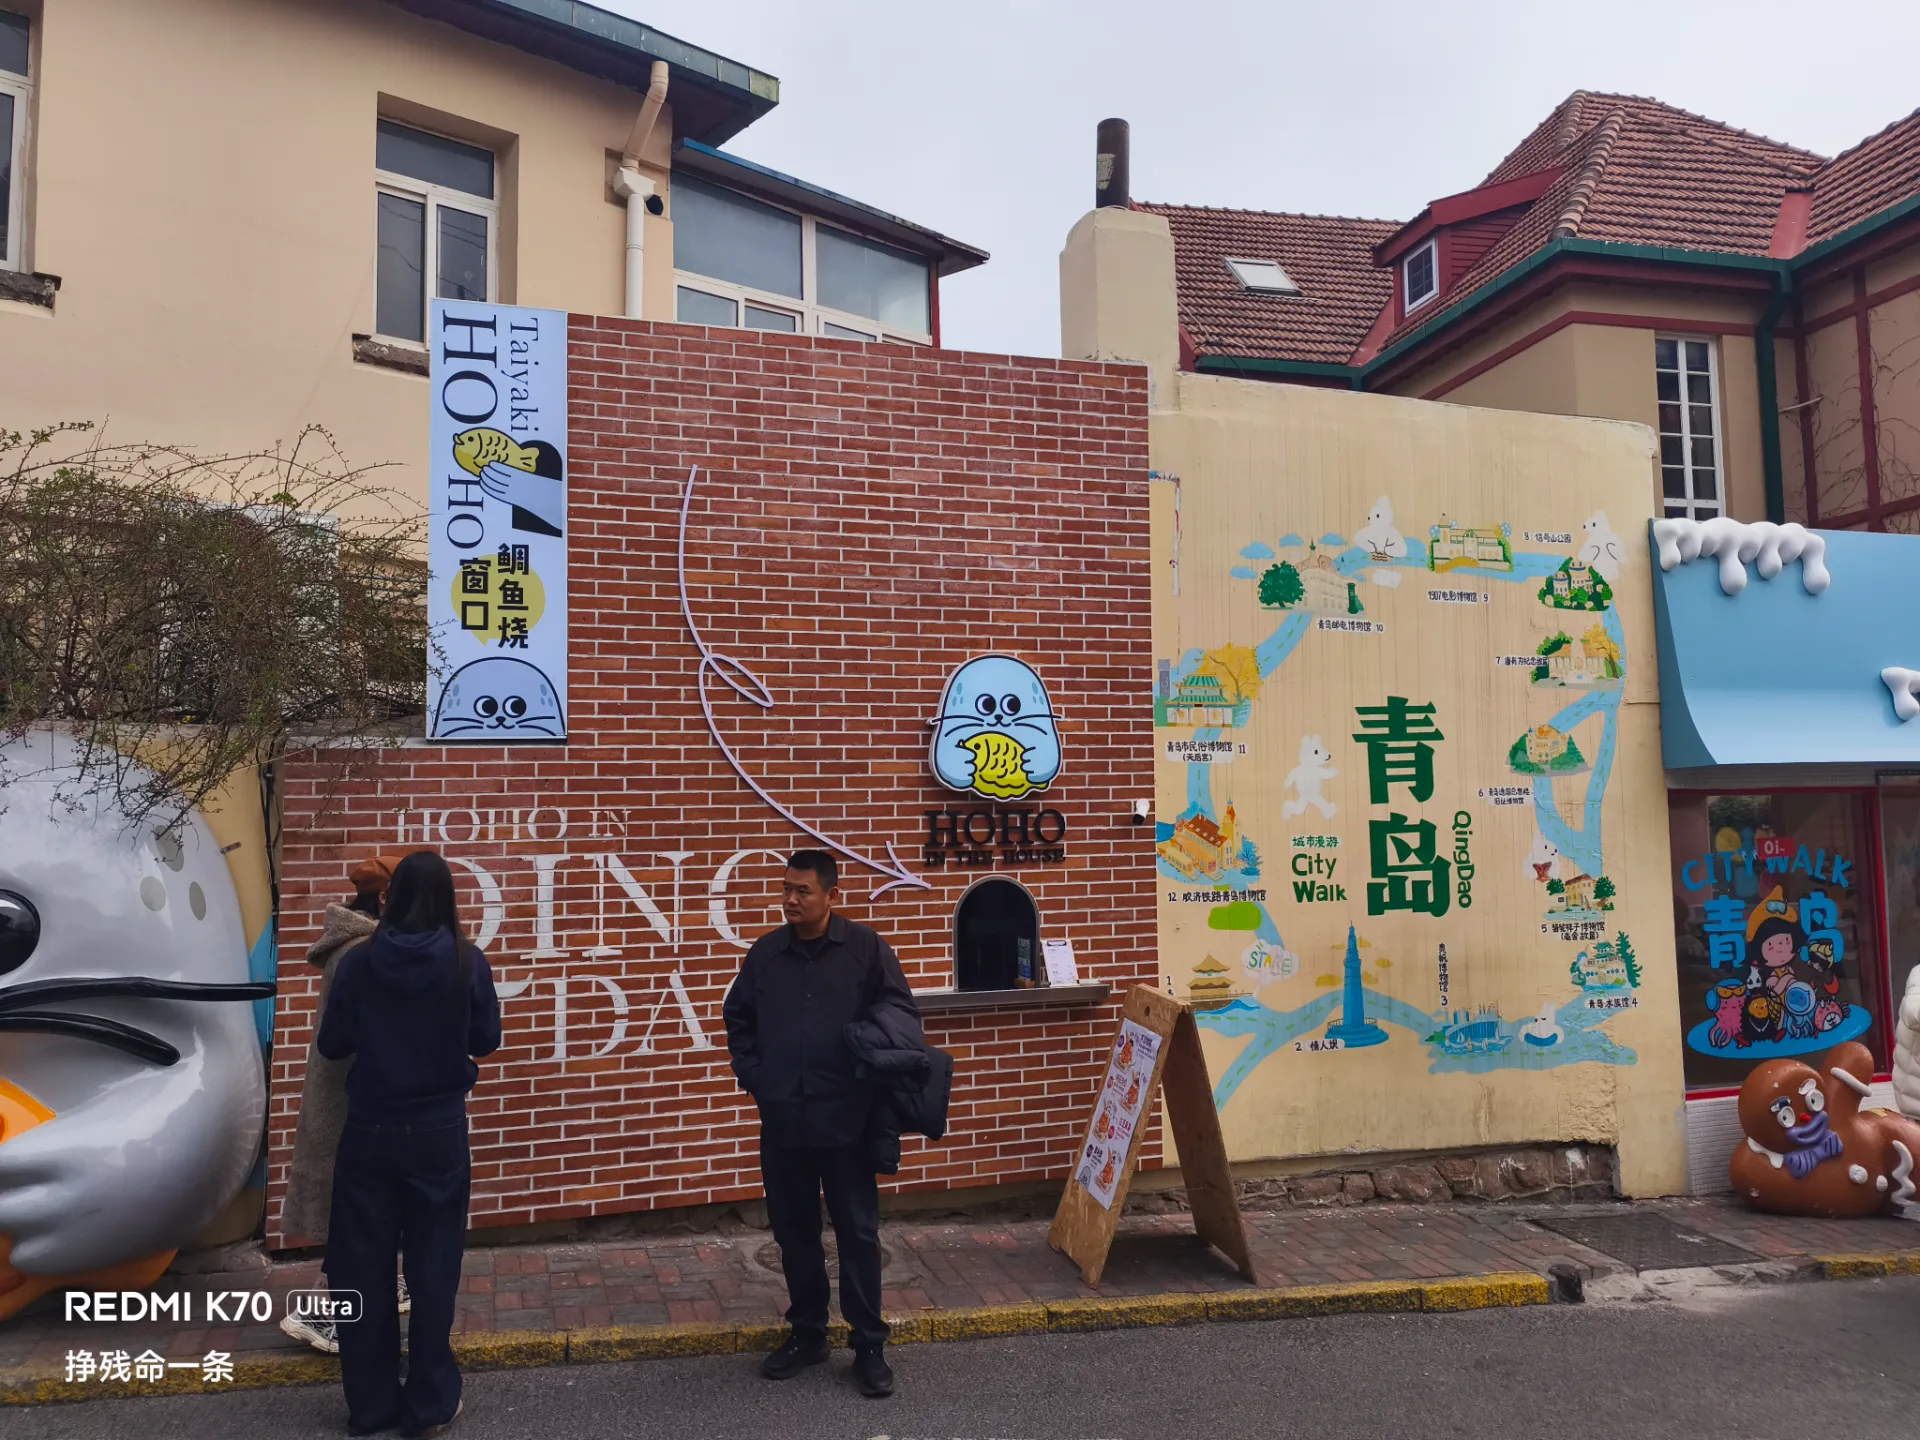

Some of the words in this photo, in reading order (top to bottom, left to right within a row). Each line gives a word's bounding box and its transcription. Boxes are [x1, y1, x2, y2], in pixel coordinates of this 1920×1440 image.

[442, 309, 498, 424] HO
[501, 317, 539, 432] Taiyaki
[447, 473, 484, 549] HO
[1524, 531, 1530, 541] 8
[459, 557, 491, 631] 窗口
[497, 543, 529, 649] 鲷鱼烧
[1483, 593, 1489, 602] 9
[1318, 619, 1372, 632] 青岛邮电博物馆
[1376, 624, 1384, 632] 10
[1495, 656, 1501, 665] 7
[1167, 741, 1233, 752] 青岛市民俗博物馆
[1238, 744, 1246, 754] 11
[1478, 788, 1484, 797] 6
[1352, 696, 1451, 917] 青岛
[394, 808, 568, 842] HOHO
[588, 809, 632, 838] IN
[924, 809, 1066, 847] HOHO
[1292, 835, 1339, 848] 城市漫游
[924, 851, 946, 866] IN
[954, 849, 994, 865] THE
[1002, 847, 1066, 863] HOUSE
[1452, 810, 1475, 909] QingDao
[1292, 853, 1337, 879] City
[1682, 849, 1758, 892] CITY
[1765, 844, 1852, 888] WALK
[1168, 892, 1177, 901] 12
[1182, 890, 1267, 902] 胶济铁路青岛博物馆
[1292, 880, 1348, 903] Walk
[1541, 924, 1547, 933] 5
[1166, 975, 1172, 985] 1
[1441, 995, 1448, 1006] 3
[1588, 997, 1629, 1008] 青岛水族馆
[1632, 997, 1638, 1008] 4
[1295, 1042, 1302, 1051] 2
